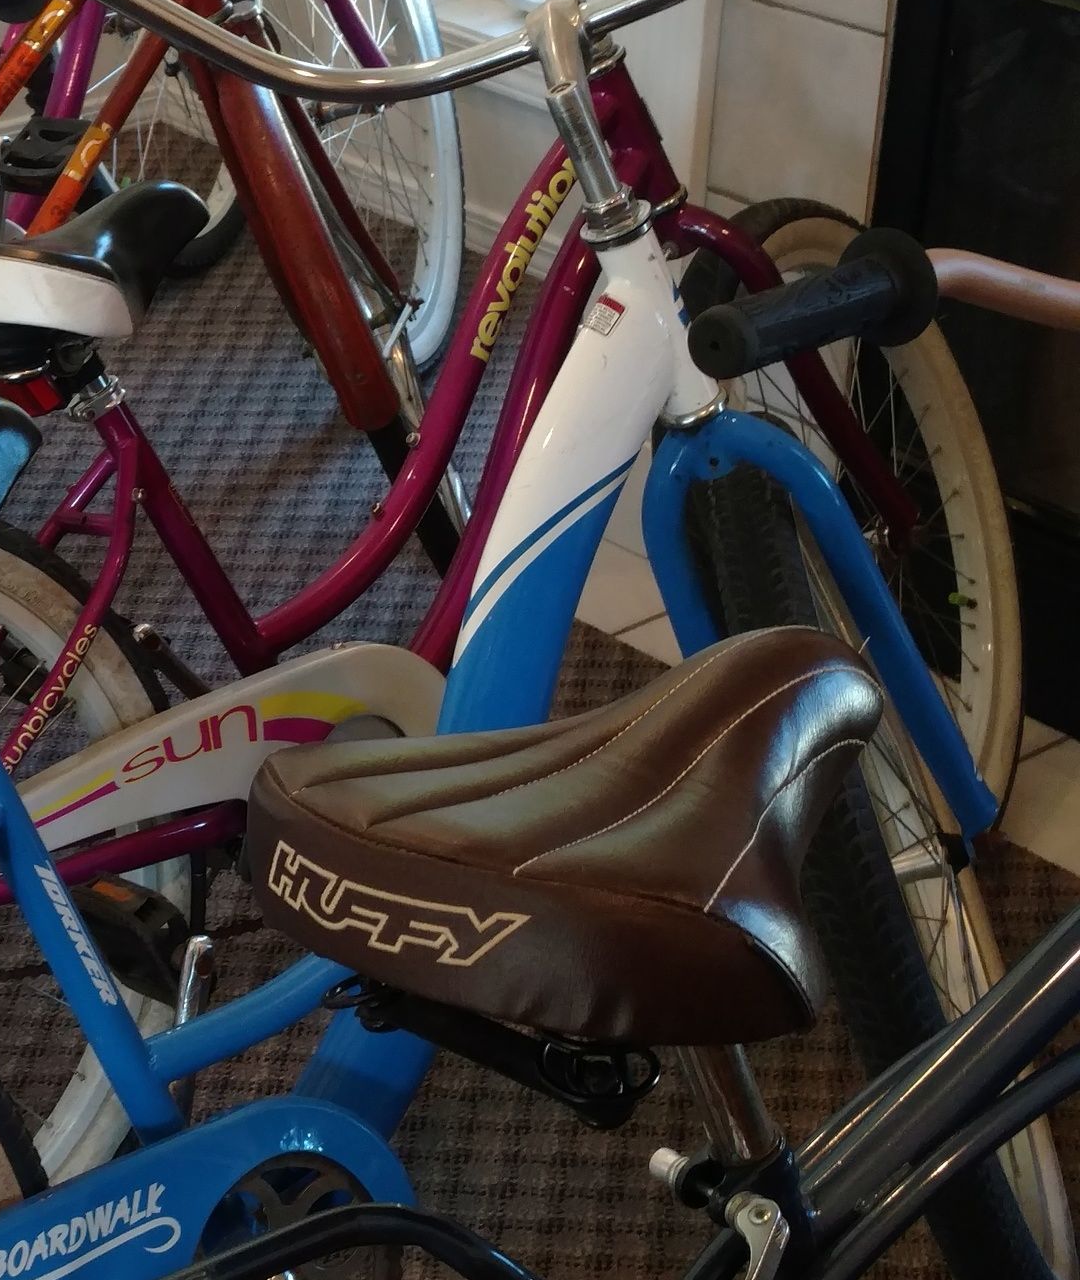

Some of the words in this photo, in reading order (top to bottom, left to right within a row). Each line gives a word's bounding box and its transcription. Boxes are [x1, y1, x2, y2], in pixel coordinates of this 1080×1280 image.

[470, 157, 581, 363] revolutio
[121, 704, 259, 784] sun
[33, 859, 119, 1006] TORKER
[268, 840, 532, 967] HUFFY
